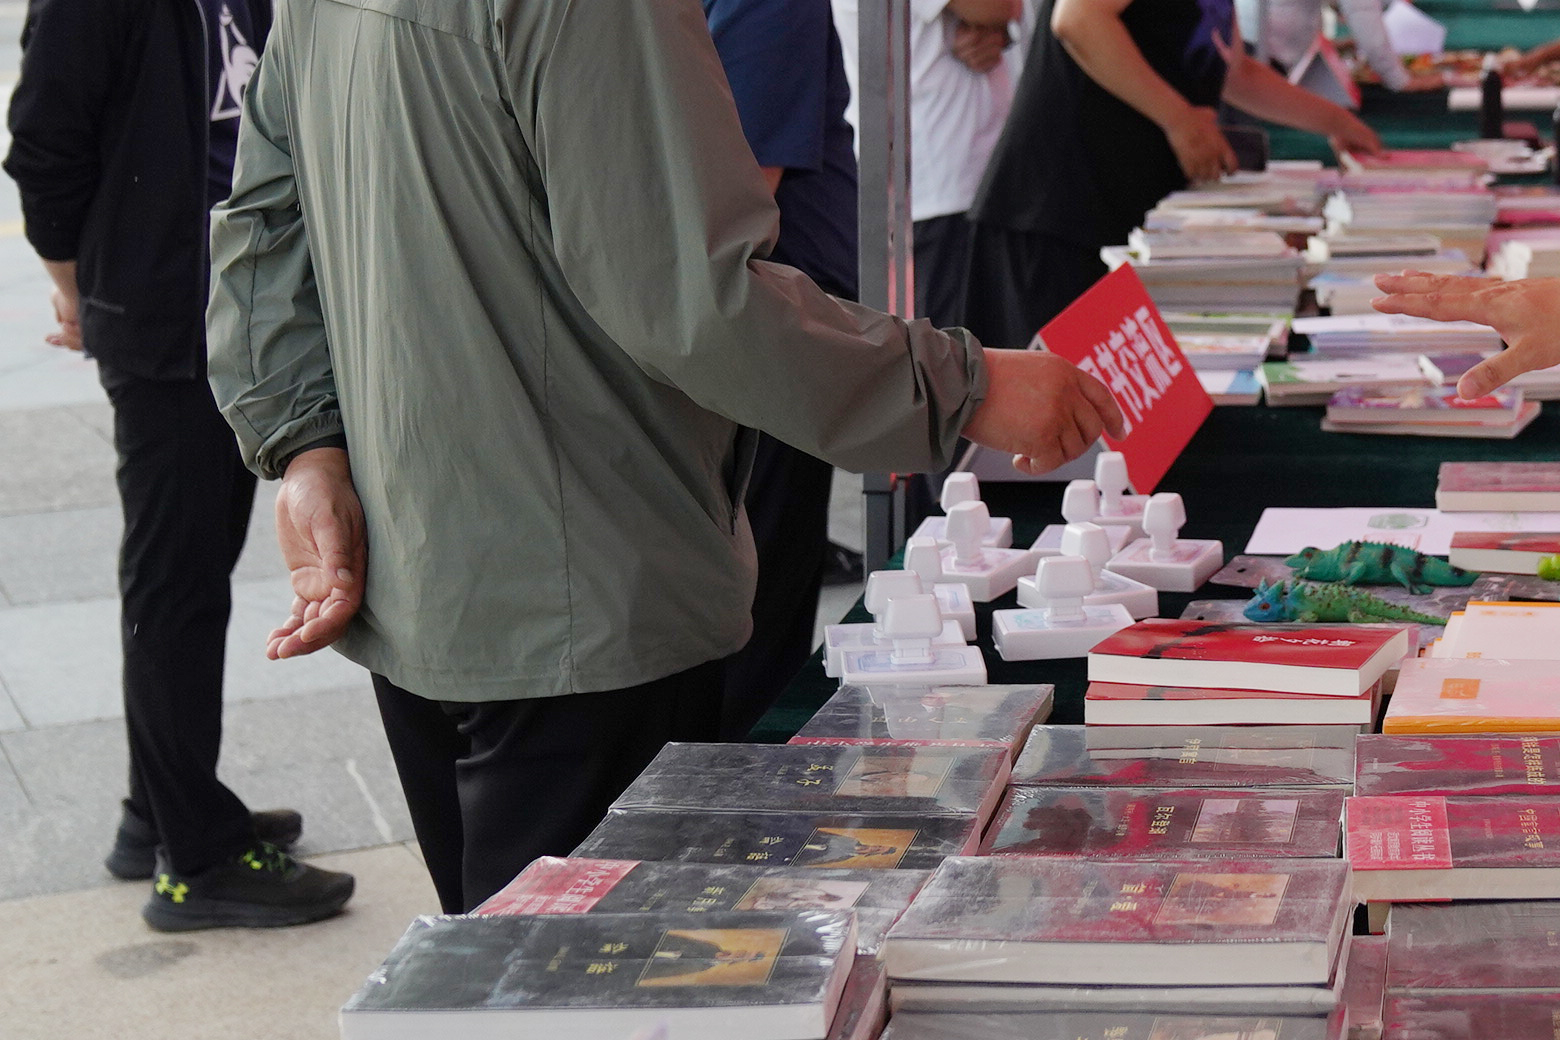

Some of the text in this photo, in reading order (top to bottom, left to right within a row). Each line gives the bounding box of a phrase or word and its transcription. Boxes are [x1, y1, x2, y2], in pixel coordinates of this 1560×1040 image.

[1147, 804, 1175, 836] 瓦尔登湖
[1408, 801, 1432, 862] 中小学生阅读丛书
[1517, 808, 1544, 850] 中国寓言故事
